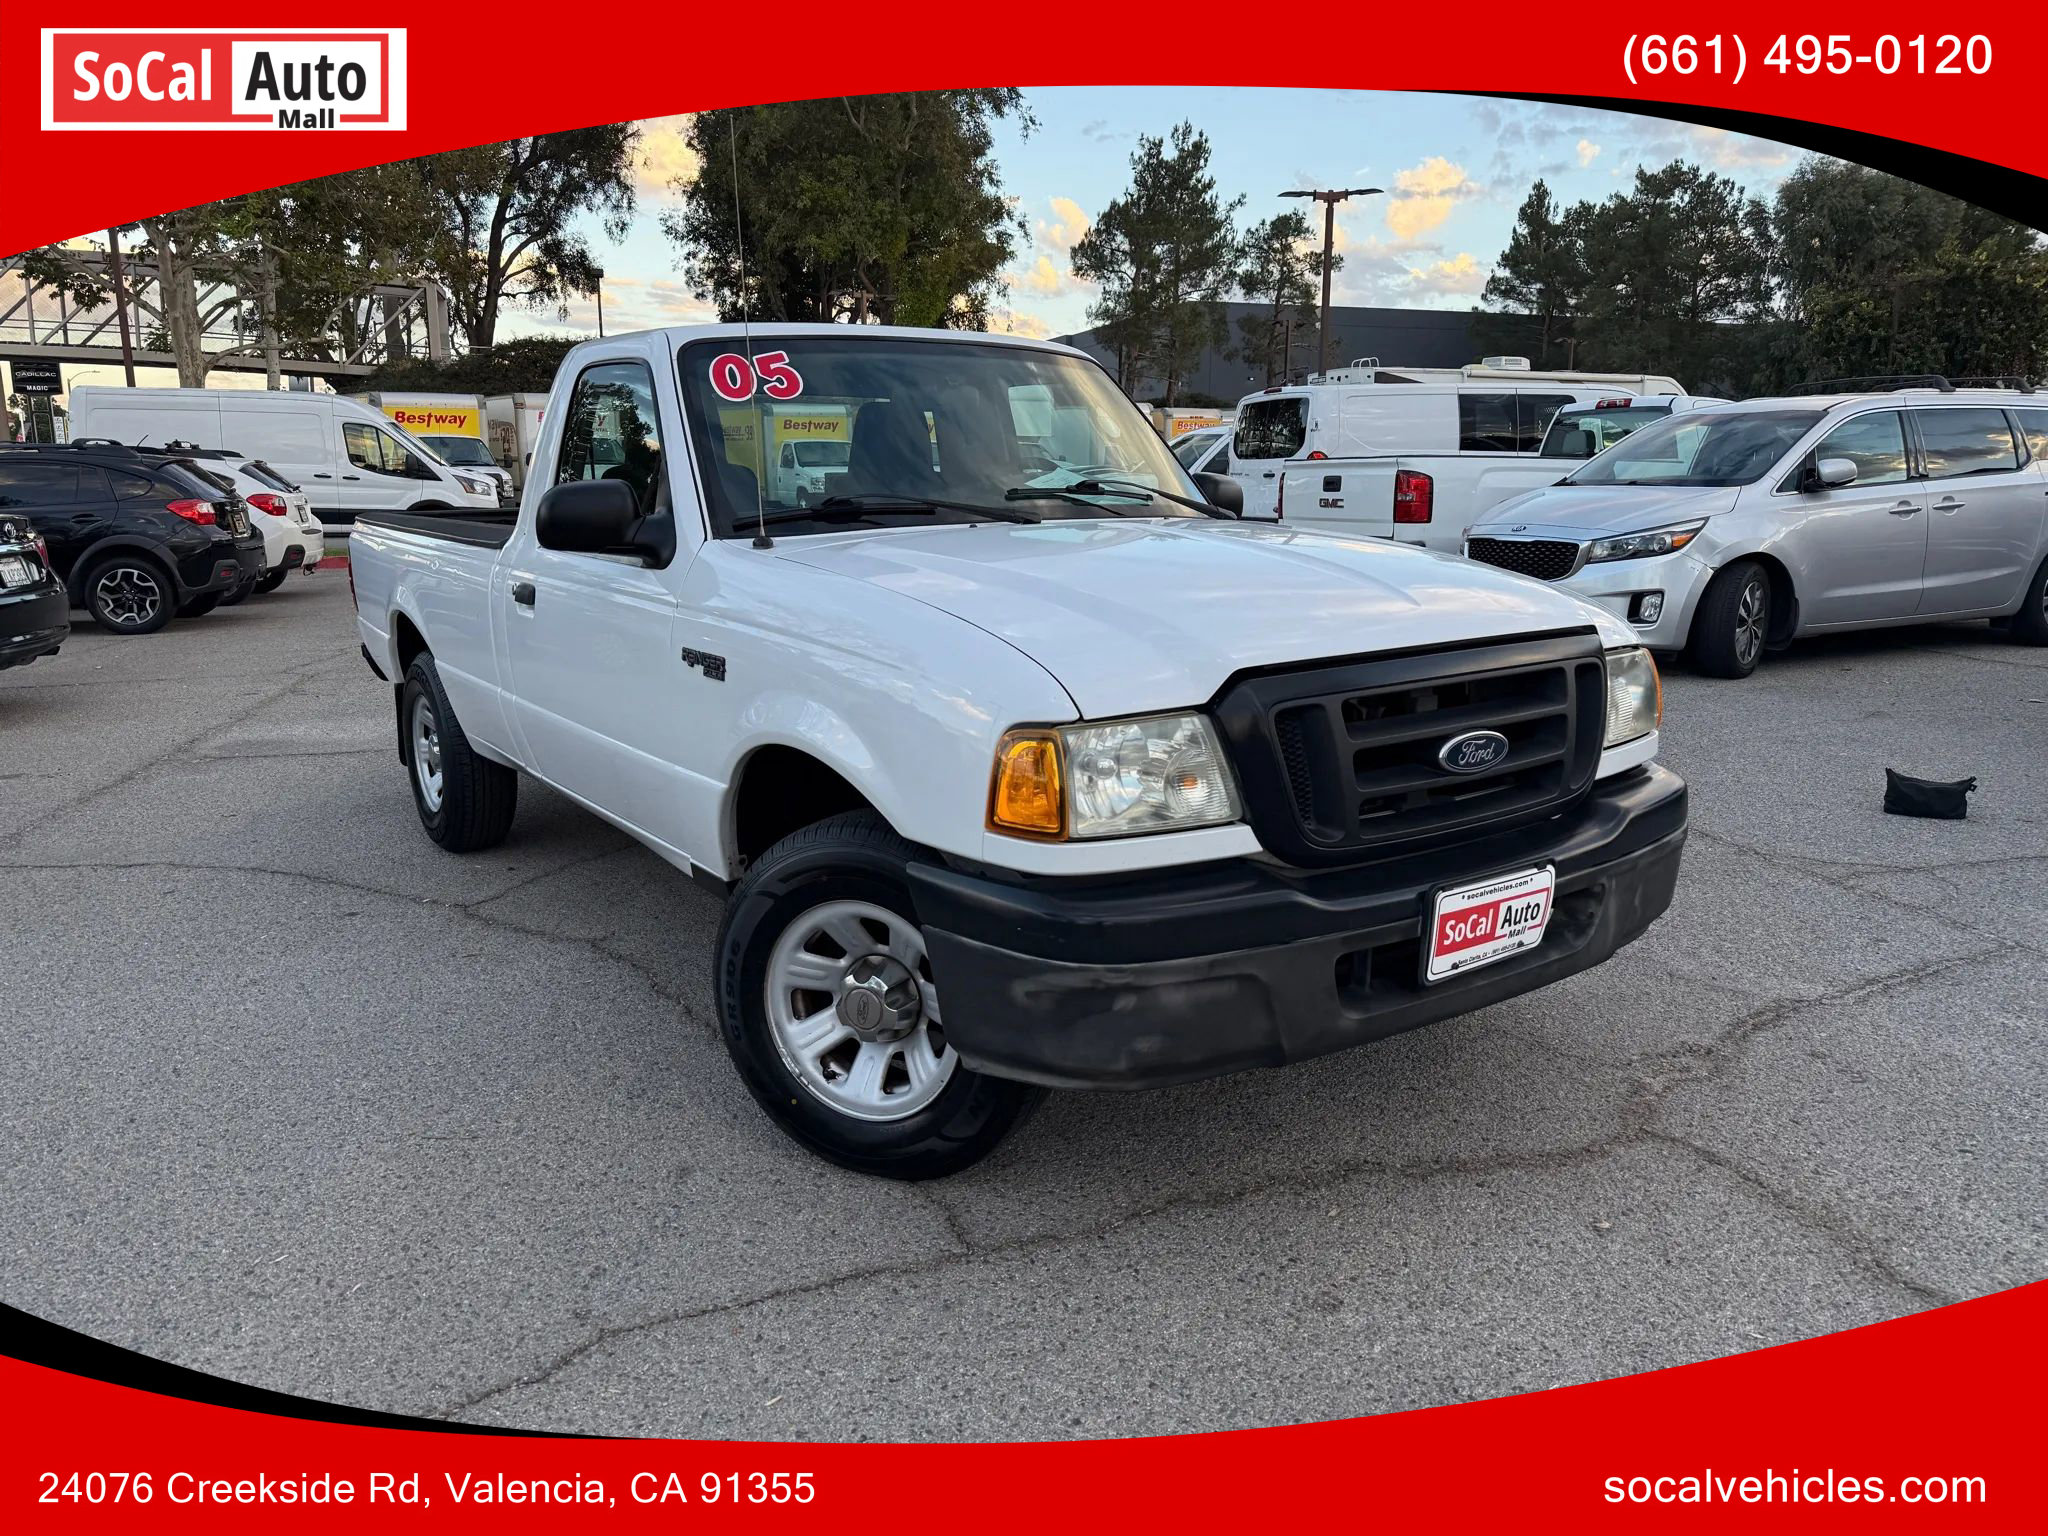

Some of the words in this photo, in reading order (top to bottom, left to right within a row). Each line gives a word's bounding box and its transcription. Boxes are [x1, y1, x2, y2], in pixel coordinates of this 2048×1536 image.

[709, 350, 803, 401] 05
[394, 411, 468, 428] Bestway
[783, 419, 840, 433] Bestway
[1319, 498, 1345, 508] GMC
[1458, 739, 1496, 766] Ford
[1467, 879, 1529, 901] socalvehicles.com
[1443, 908, 1494, 945] SoCal
[1500, 901, 1541, 930] Auto
[1507, 925, 1527, 939] Mall
